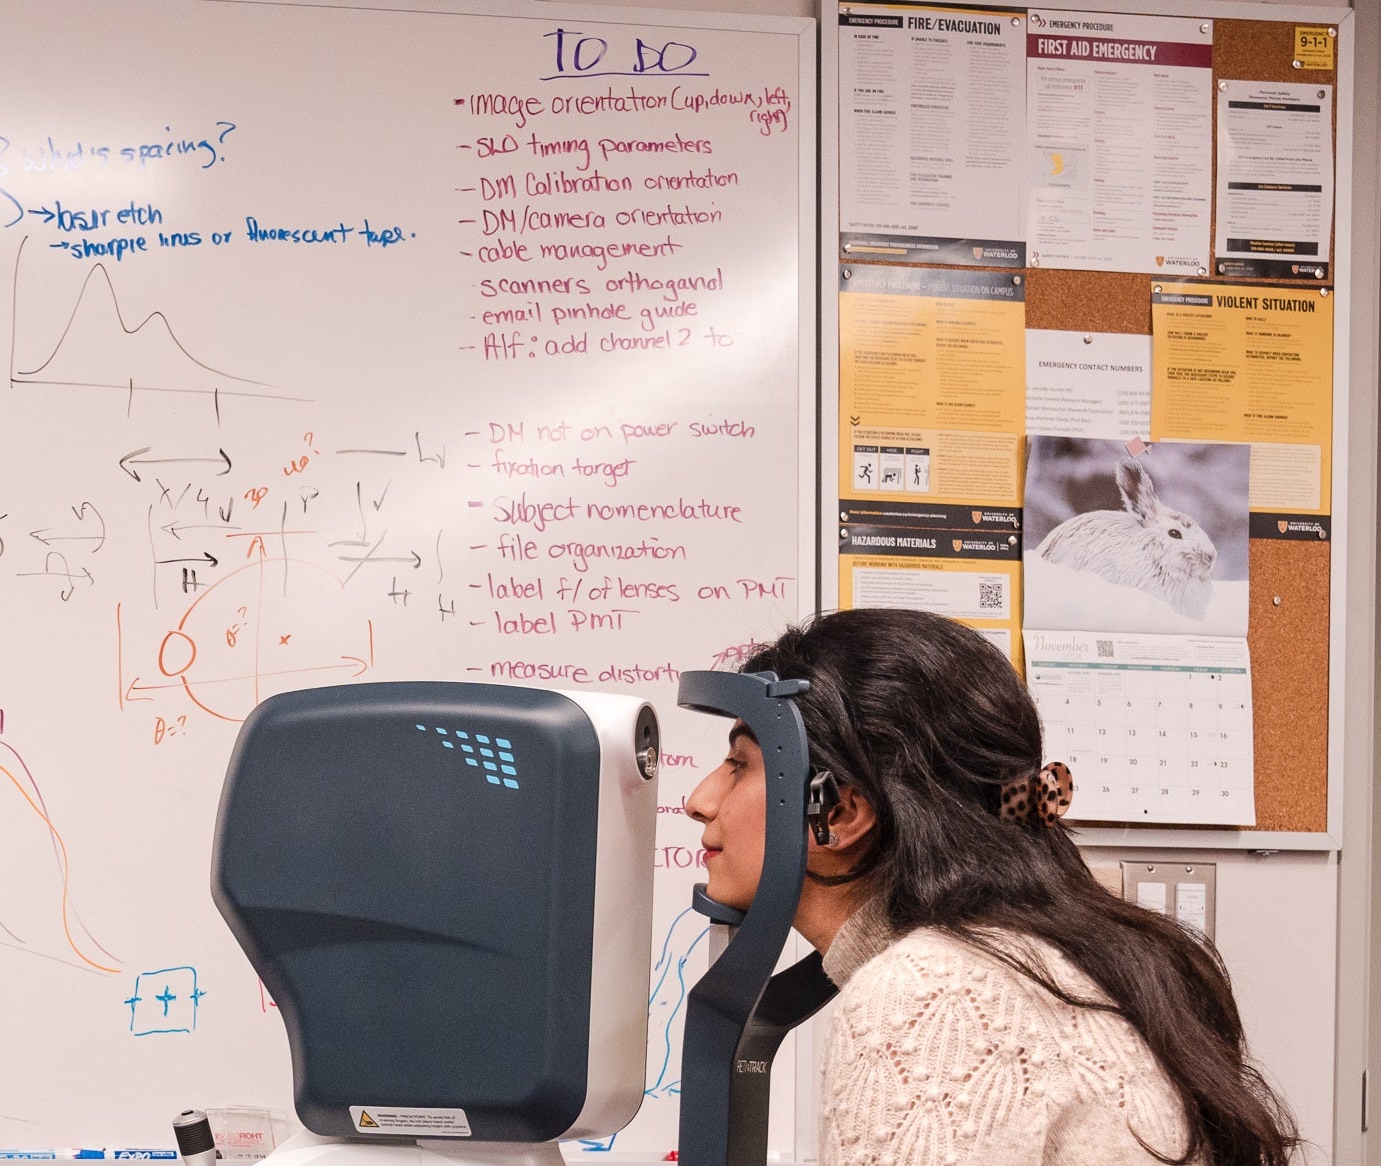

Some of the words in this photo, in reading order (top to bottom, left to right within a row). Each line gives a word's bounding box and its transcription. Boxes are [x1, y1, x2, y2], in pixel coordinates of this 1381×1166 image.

[908, 17, 1001, 35] FIRE/EVACUATION
[1049, 20, 1081, 30] EMERGENCY
[1082, 22, 1114, 31] PROCEDURE
[543, 28, 608, 73] TO
[633, 38, 698, 73] DO
[1038, 38, 1068, 55] FIRST
[1070, 41, 1090, 56] AID
[1093, 42, 1157, 60] EMERGENCY
[1300, 36, 1327, 48] 9-1-1
[527, 133, 591, 172] timing
[599, 133, 713, 164] parameters
[480, 174, 517, 202] DM
[477, 238, 533, 264] cable
[541, 236, 683, 271] management
[480, 278, 592, 298] scanners
[980, 287, 991, 295] ON
[991, 287, 1014, 297] CAMPUS
[482, 302, 542, 326] email
[1217, 296, 1259, 309] VIOLENT
[1262, 298, 1315, 313] SITUATION
[545, 330, 588, 357] add
[1038, 361, 1077, 370] EMERGENCY
[1079, 363, 1109, 371] CONTACT
[1110, 365, 1143, 373] NUMBERS
[572, 457, 636, 487] target
[497, 533, 538, 561] file
[852, 535, 896, 547] HAZARDOUS
[897, 538, 937, 549] MATERIALS
[487, 572, 543, 601] label
[495, 610, 556, 634] label
[1033, 635, 1089, 653] November
[490, 660, 593, 685] measure
